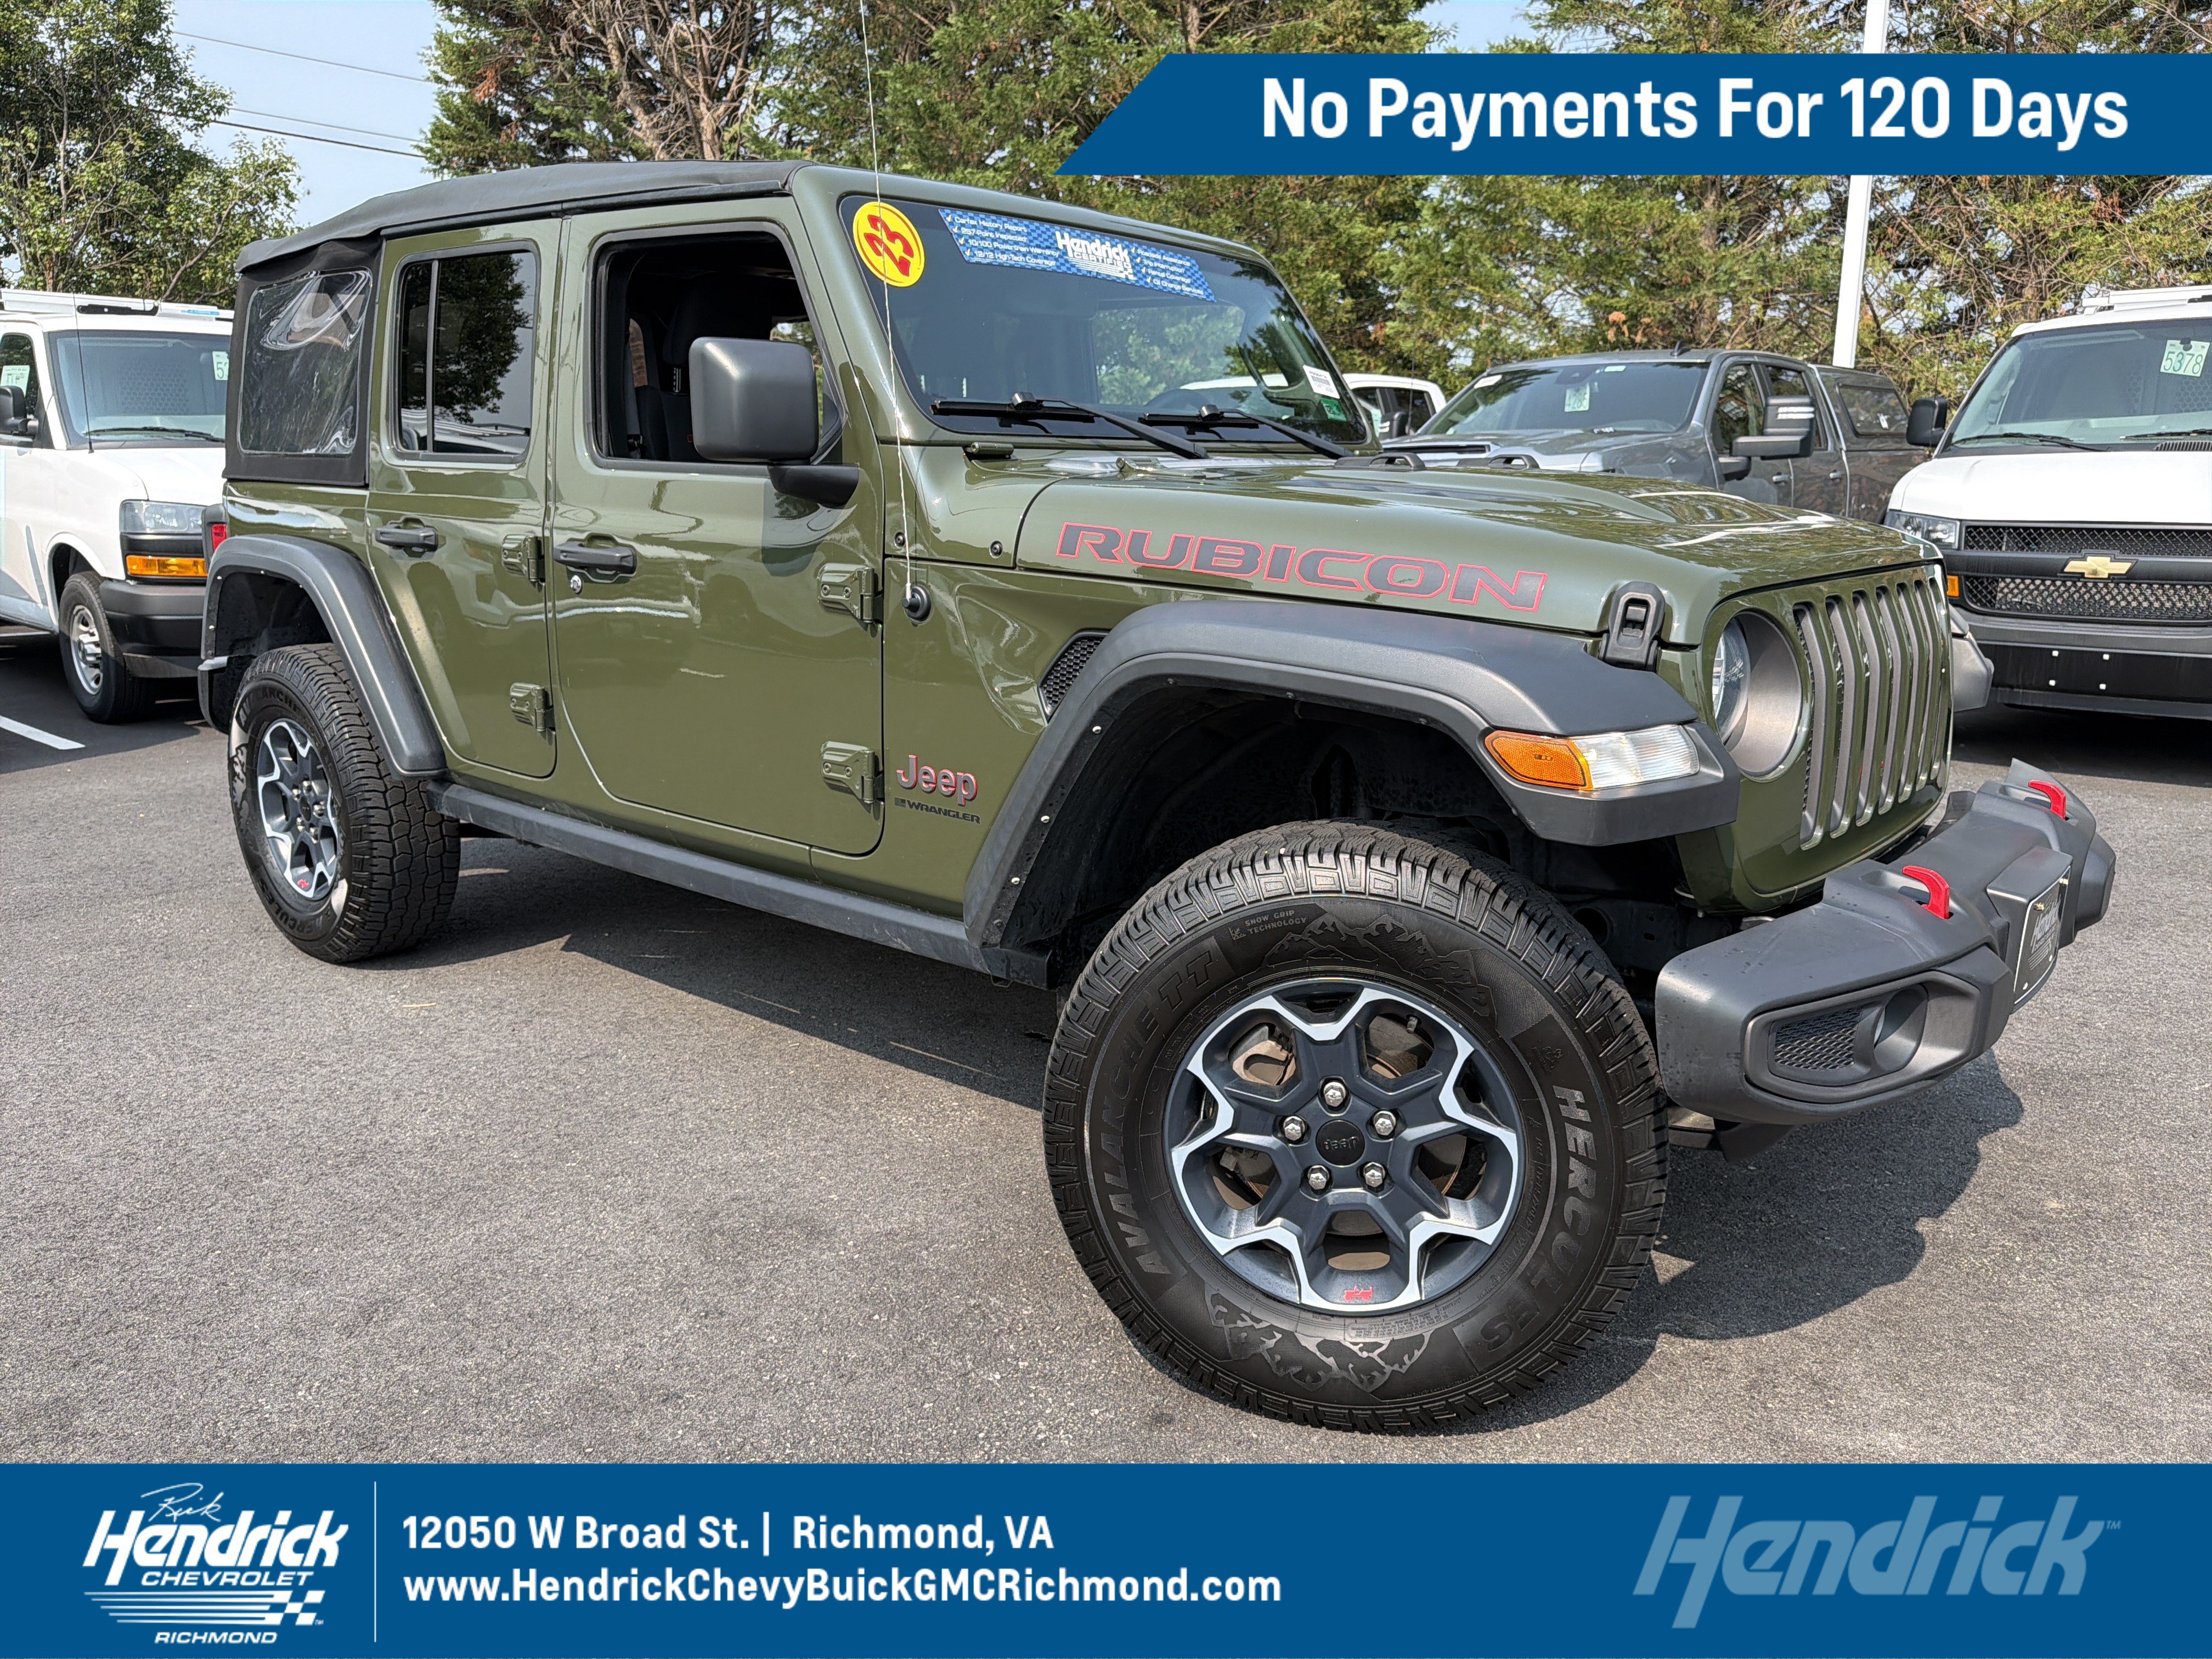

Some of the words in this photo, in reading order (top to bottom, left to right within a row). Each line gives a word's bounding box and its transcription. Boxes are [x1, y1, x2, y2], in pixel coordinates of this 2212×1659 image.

[864, 214, 914, 277] 23
[1055, 230, 1130, 263] Hendrick
[1073, 251, 1131, 269] CERTIFIED
[216, 361, 228, 380] 5
[2163, 351, 2203, 375] 5378
[1056, 522, 1548, 612] RUBICON
[896, 754, 978, 806] Jeep
[906, 800, 981, 823] WRANGLER
[1244, 914, 1269, 927] SNOW
[1273, 910, 1295, 919] GRIP
[1247, 917, 1307, 934] TECHNOLOGY
[1100, 1008, 1172, 1274] AVALANCHE
[1158, 950, 1212, 1012] TT
[1480, 1085, 1598, 1353] HERCULES
